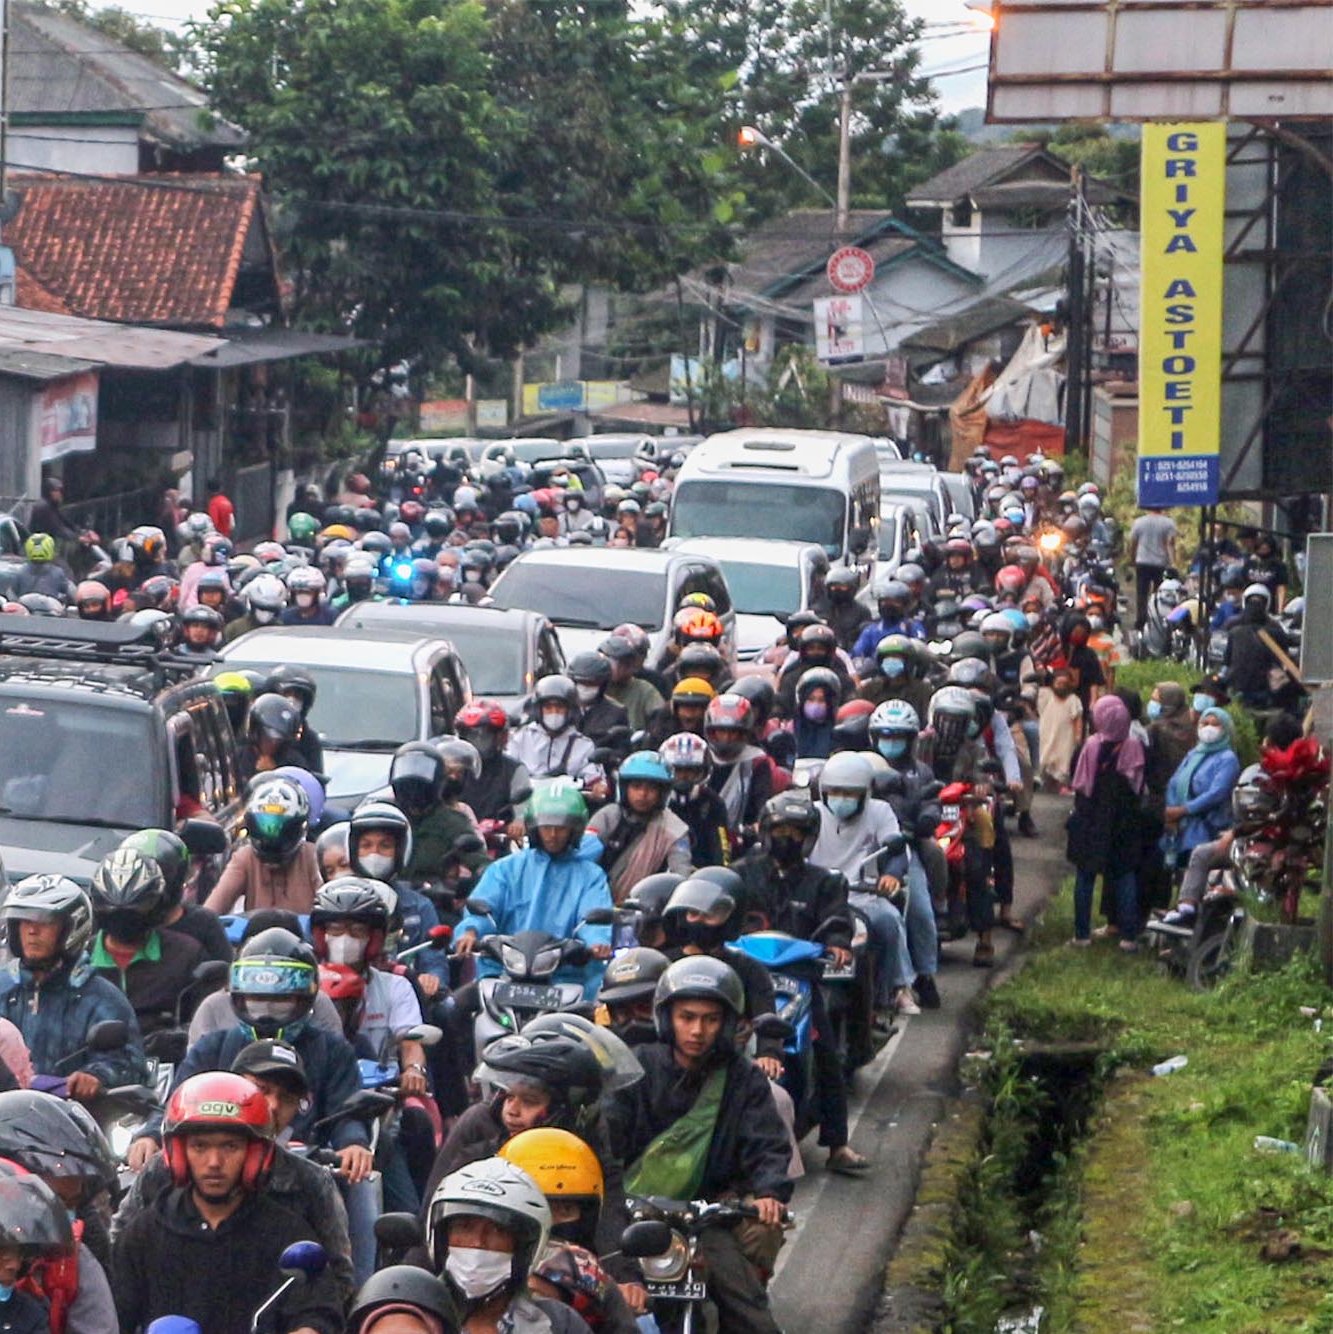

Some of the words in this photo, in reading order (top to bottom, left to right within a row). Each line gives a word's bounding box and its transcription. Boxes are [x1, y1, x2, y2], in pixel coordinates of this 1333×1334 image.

[1164, 132, 1200, 254] GRIYA
[1162, 279, 1198, 450] ASTOETI
[200, 1102, 235, 1117] agv
